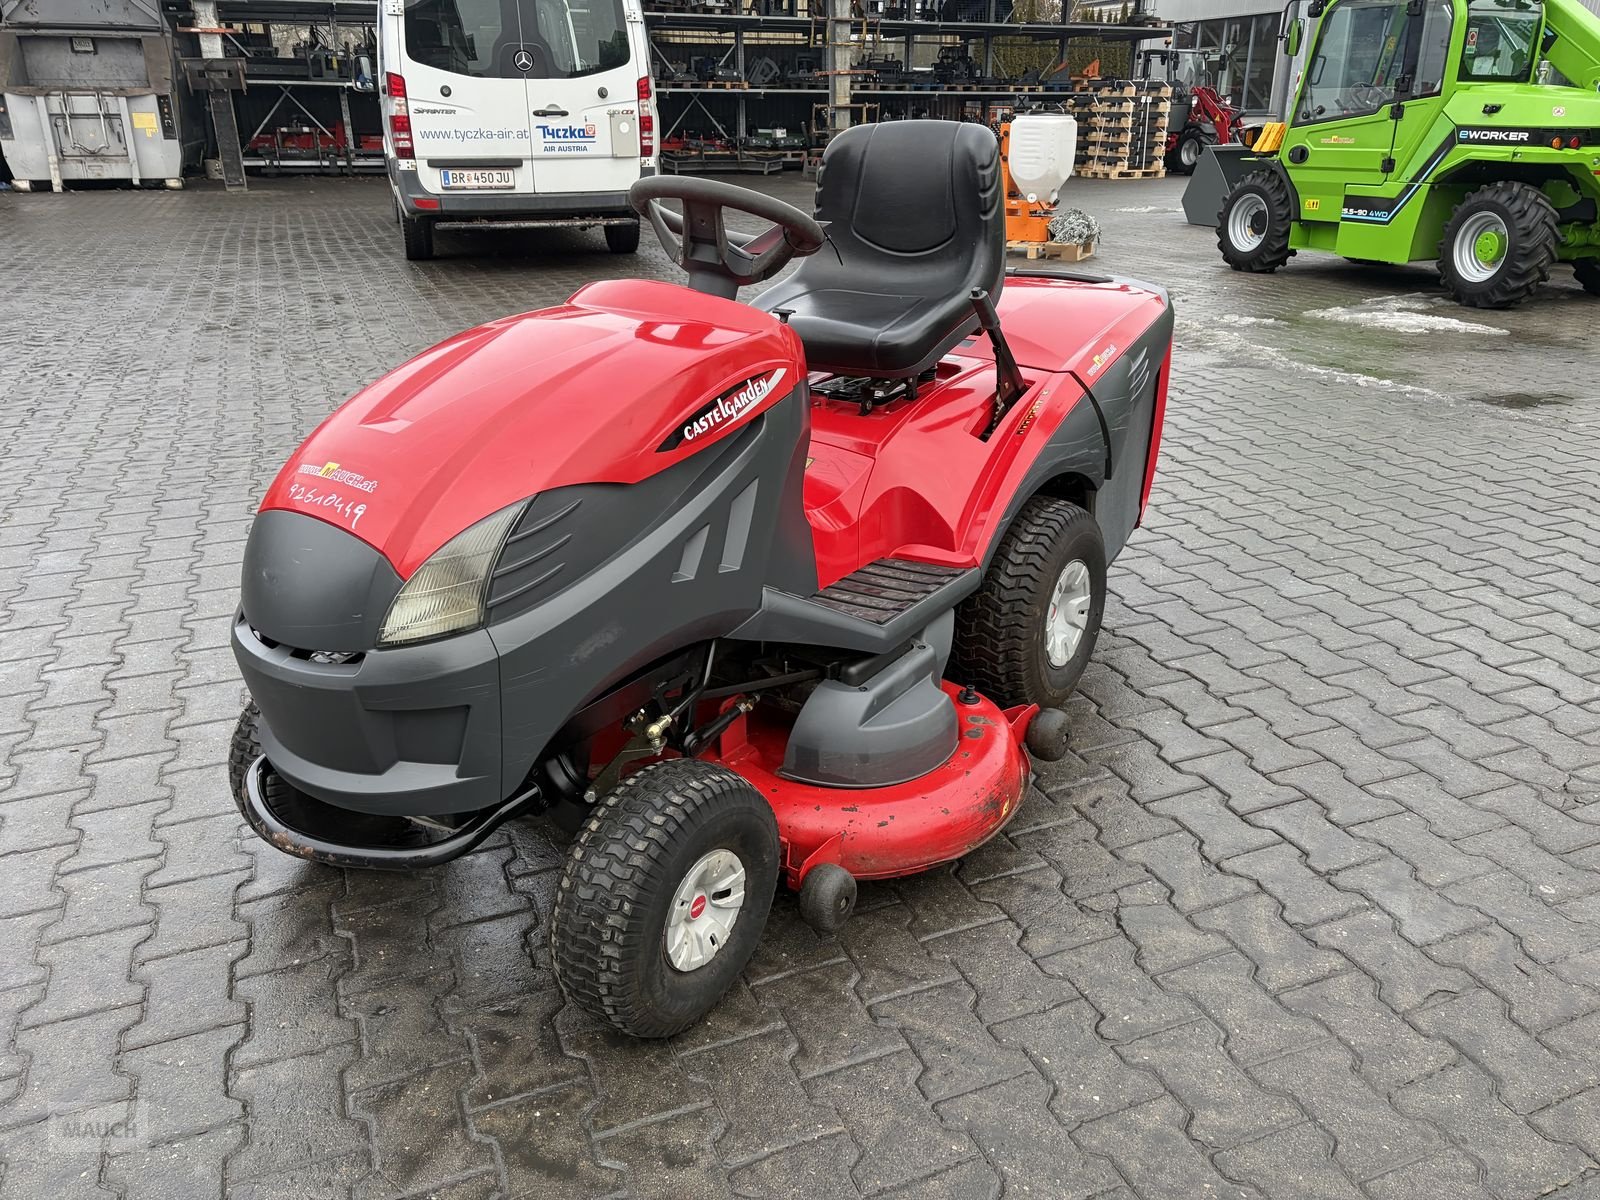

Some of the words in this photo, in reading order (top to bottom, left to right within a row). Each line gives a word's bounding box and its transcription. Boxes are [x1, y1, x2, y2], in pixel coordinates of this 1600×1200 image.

[419, 128, 530, 142] www.tyczka-air.at
[451, 172, 466, 184] BR
[473, 172, 495, 184] 450
[496, 172, 510, 184] JU
[1369, 210, 1389, 218] 4WD
[288, 483, 367, 529] 92610449
